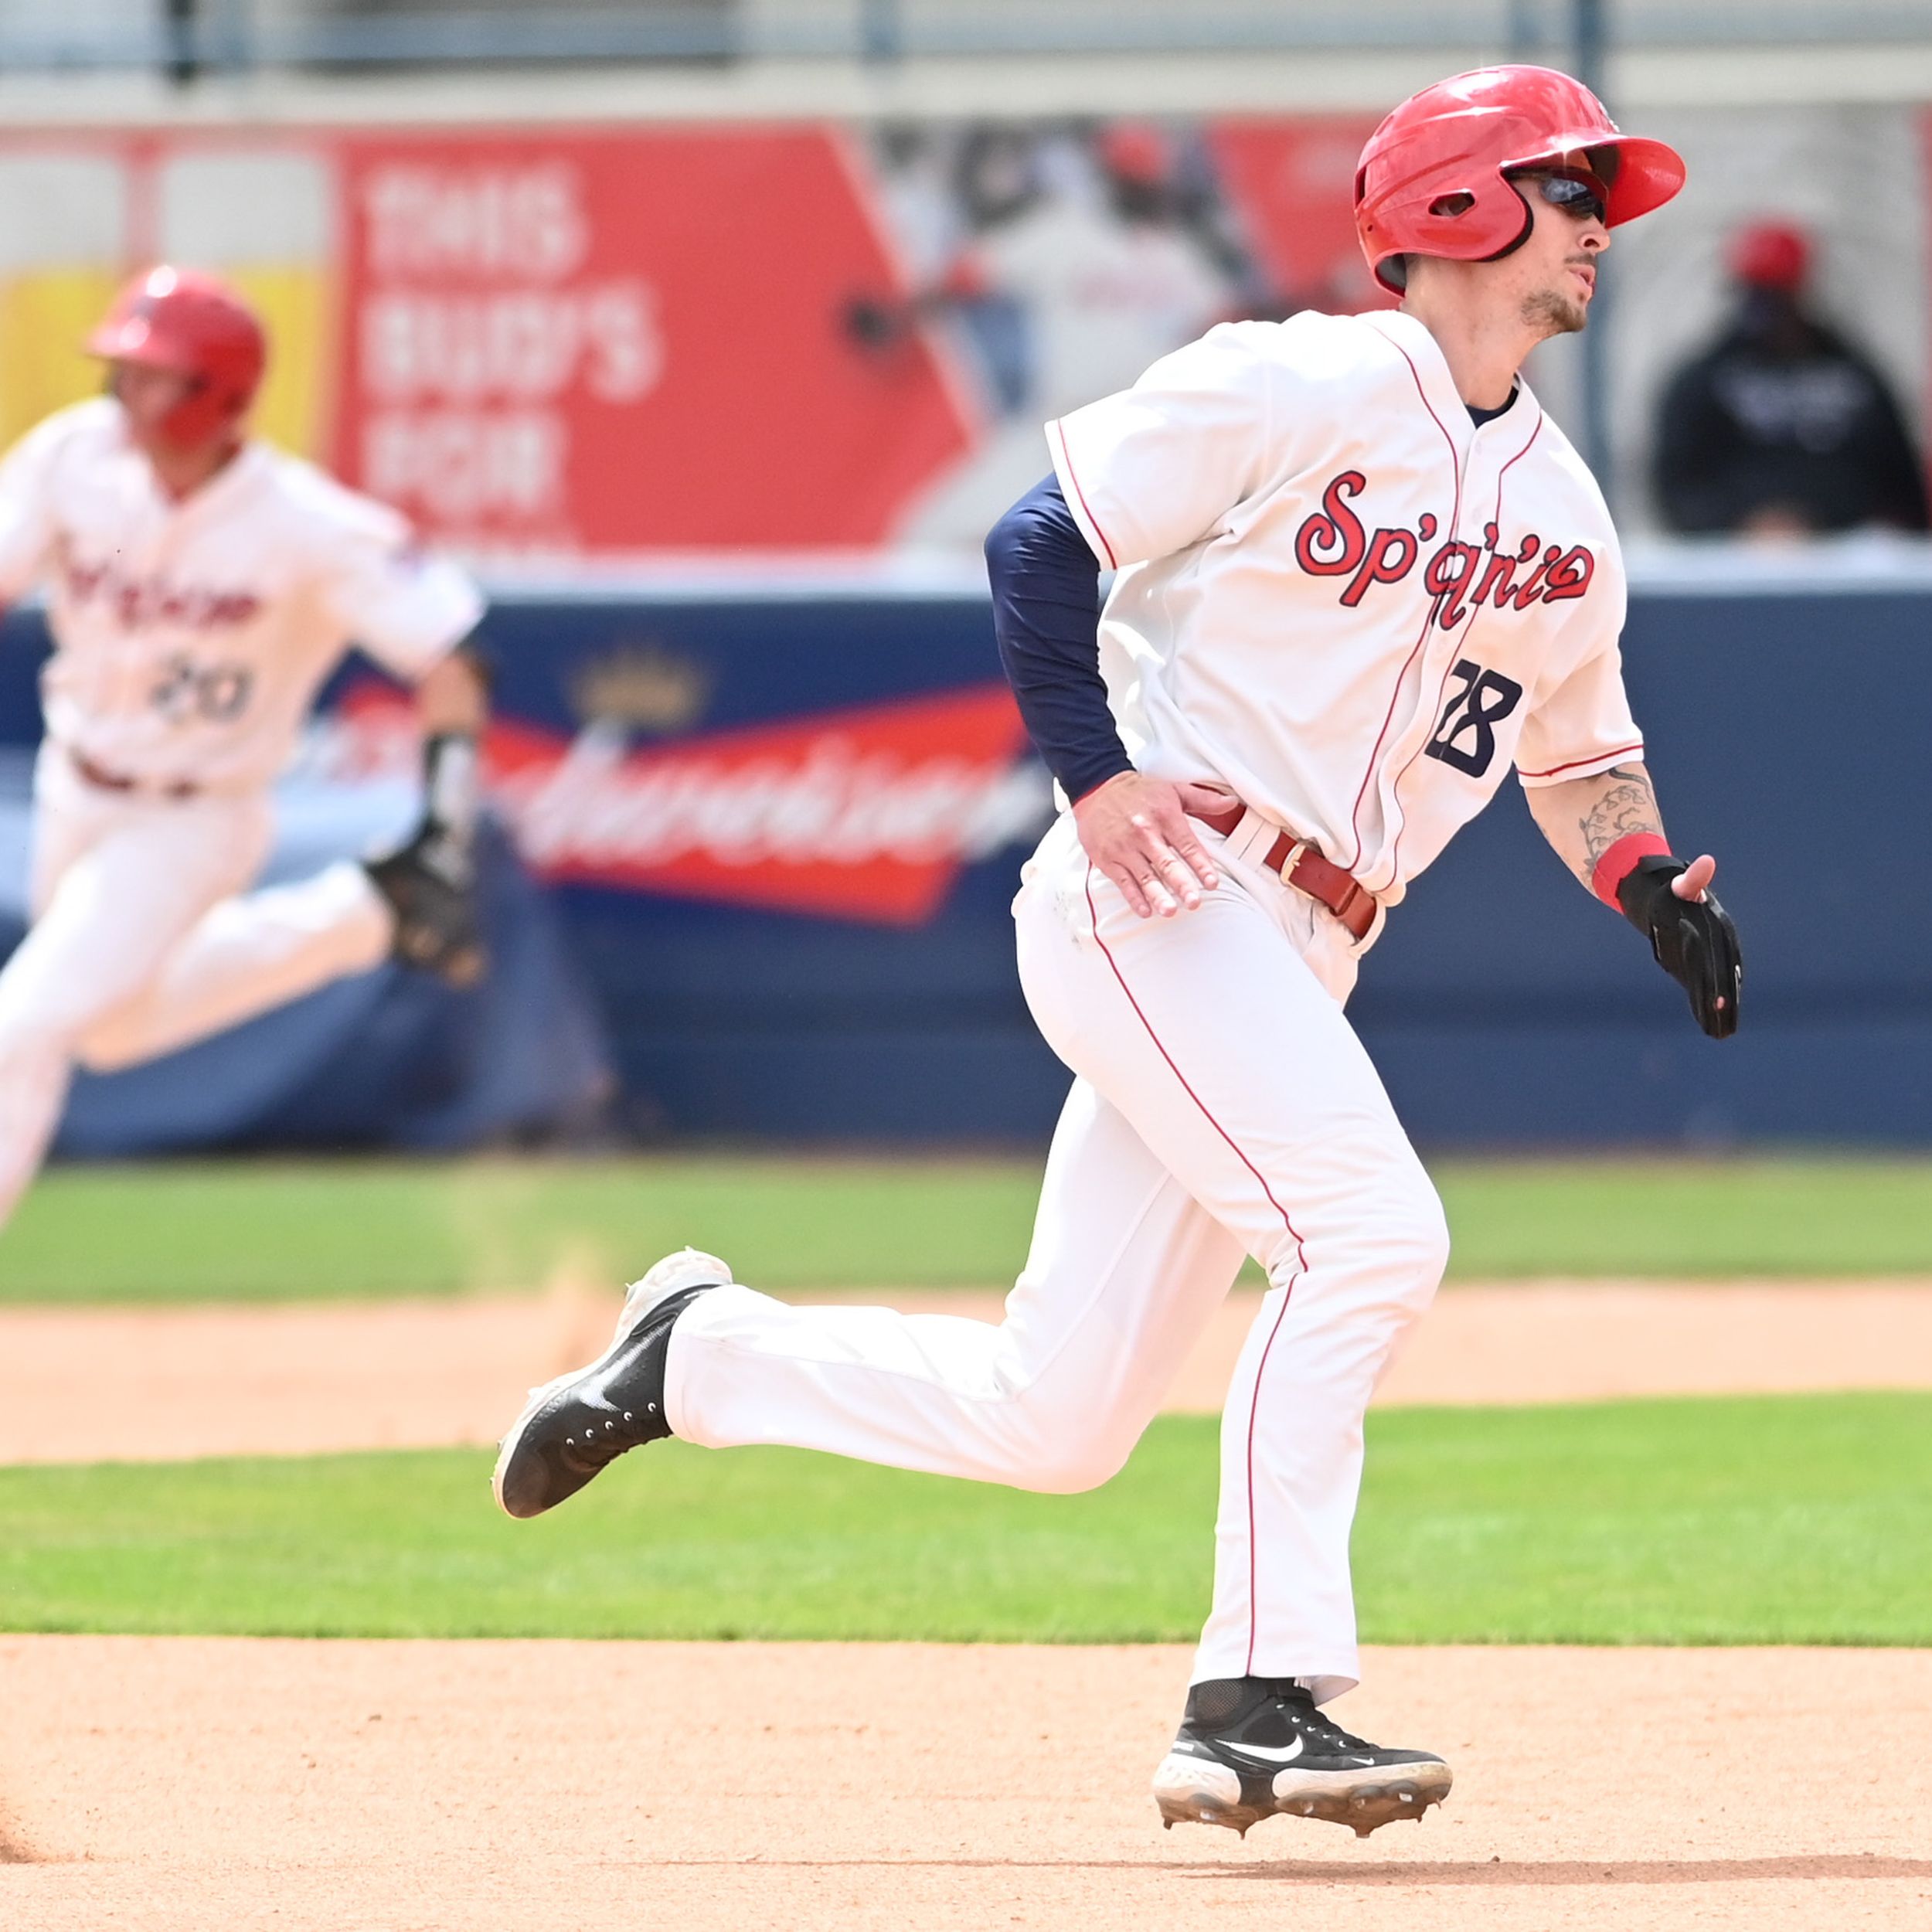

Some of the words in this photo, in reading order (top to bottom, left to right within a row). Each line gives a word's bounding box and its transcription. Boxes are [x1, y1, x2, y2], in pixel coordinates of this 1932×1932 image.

[368, 161, 585, 275] THIS
[359, 408, 569, 515] FOR
[1424, 658, 1523, 779] 28
[475, 717, 1045, 867] dweiser
